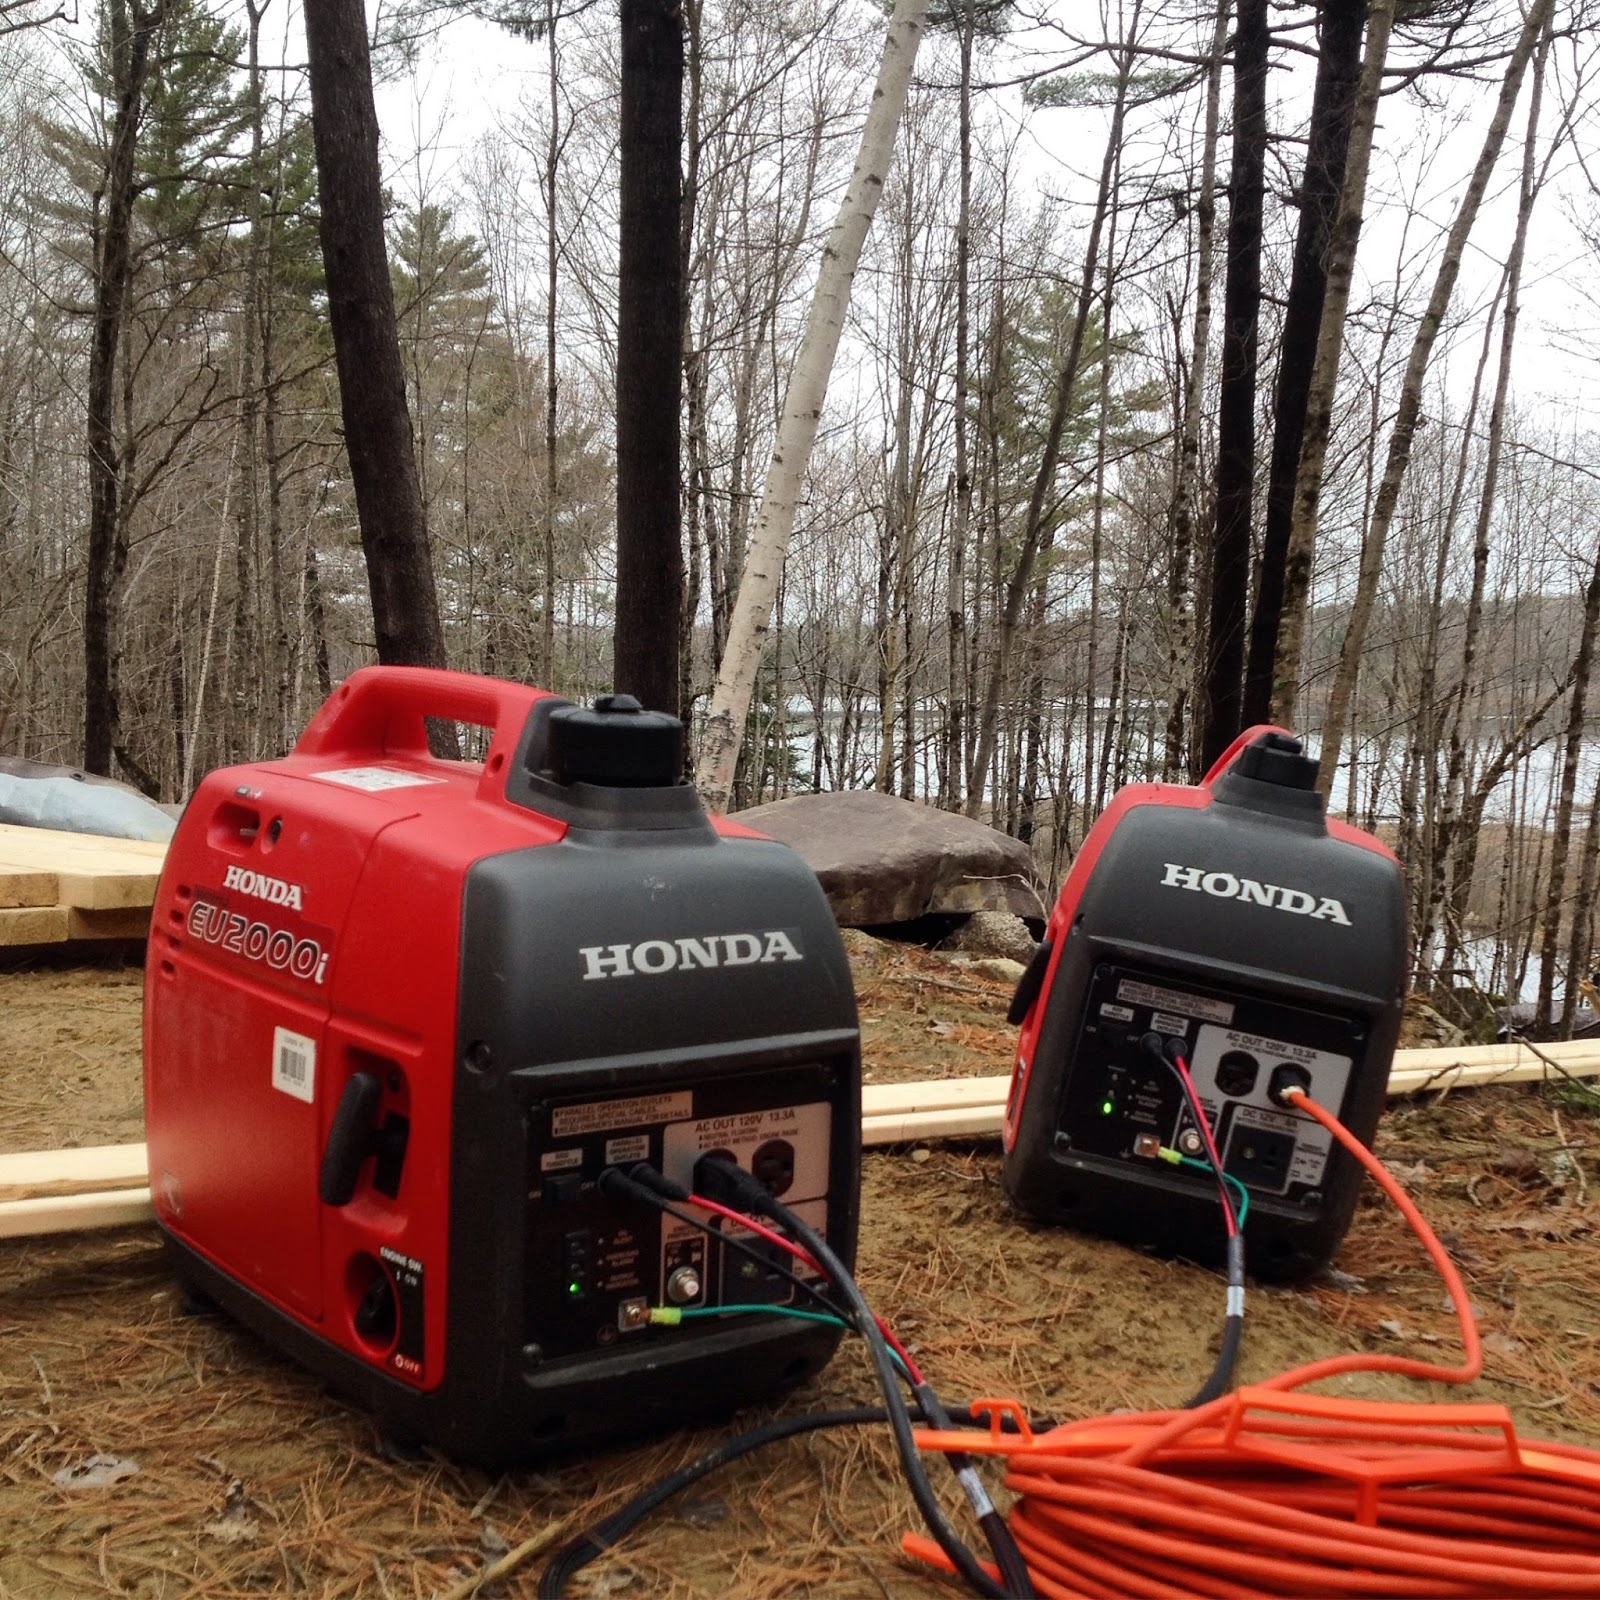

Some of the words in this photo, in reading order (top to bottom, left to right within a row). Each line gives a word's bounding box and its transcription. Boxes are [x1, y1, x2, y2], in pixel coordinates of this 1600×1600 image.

[223, 864, 303, 911] HONDA
[1160, 863, 1353, 926] HONDA
[187, 901, 329, 984] EU2000i
[579, 931, 803, 980] HONDA
[1225, 1032, 1240, 1042] AC
[1241, 1035, 1263, 1047] OUT
[1265, 1041, 1287, 1052] 120V
[1292, 1047, 1318, 1060] 13.3A
[695, 1121, 710, 1133] AC
[713, 1118, 735, 1131] OUT
[739, 1114, 764, 1126] 120V
[769, 1109, 795, 1122] 13.3A
